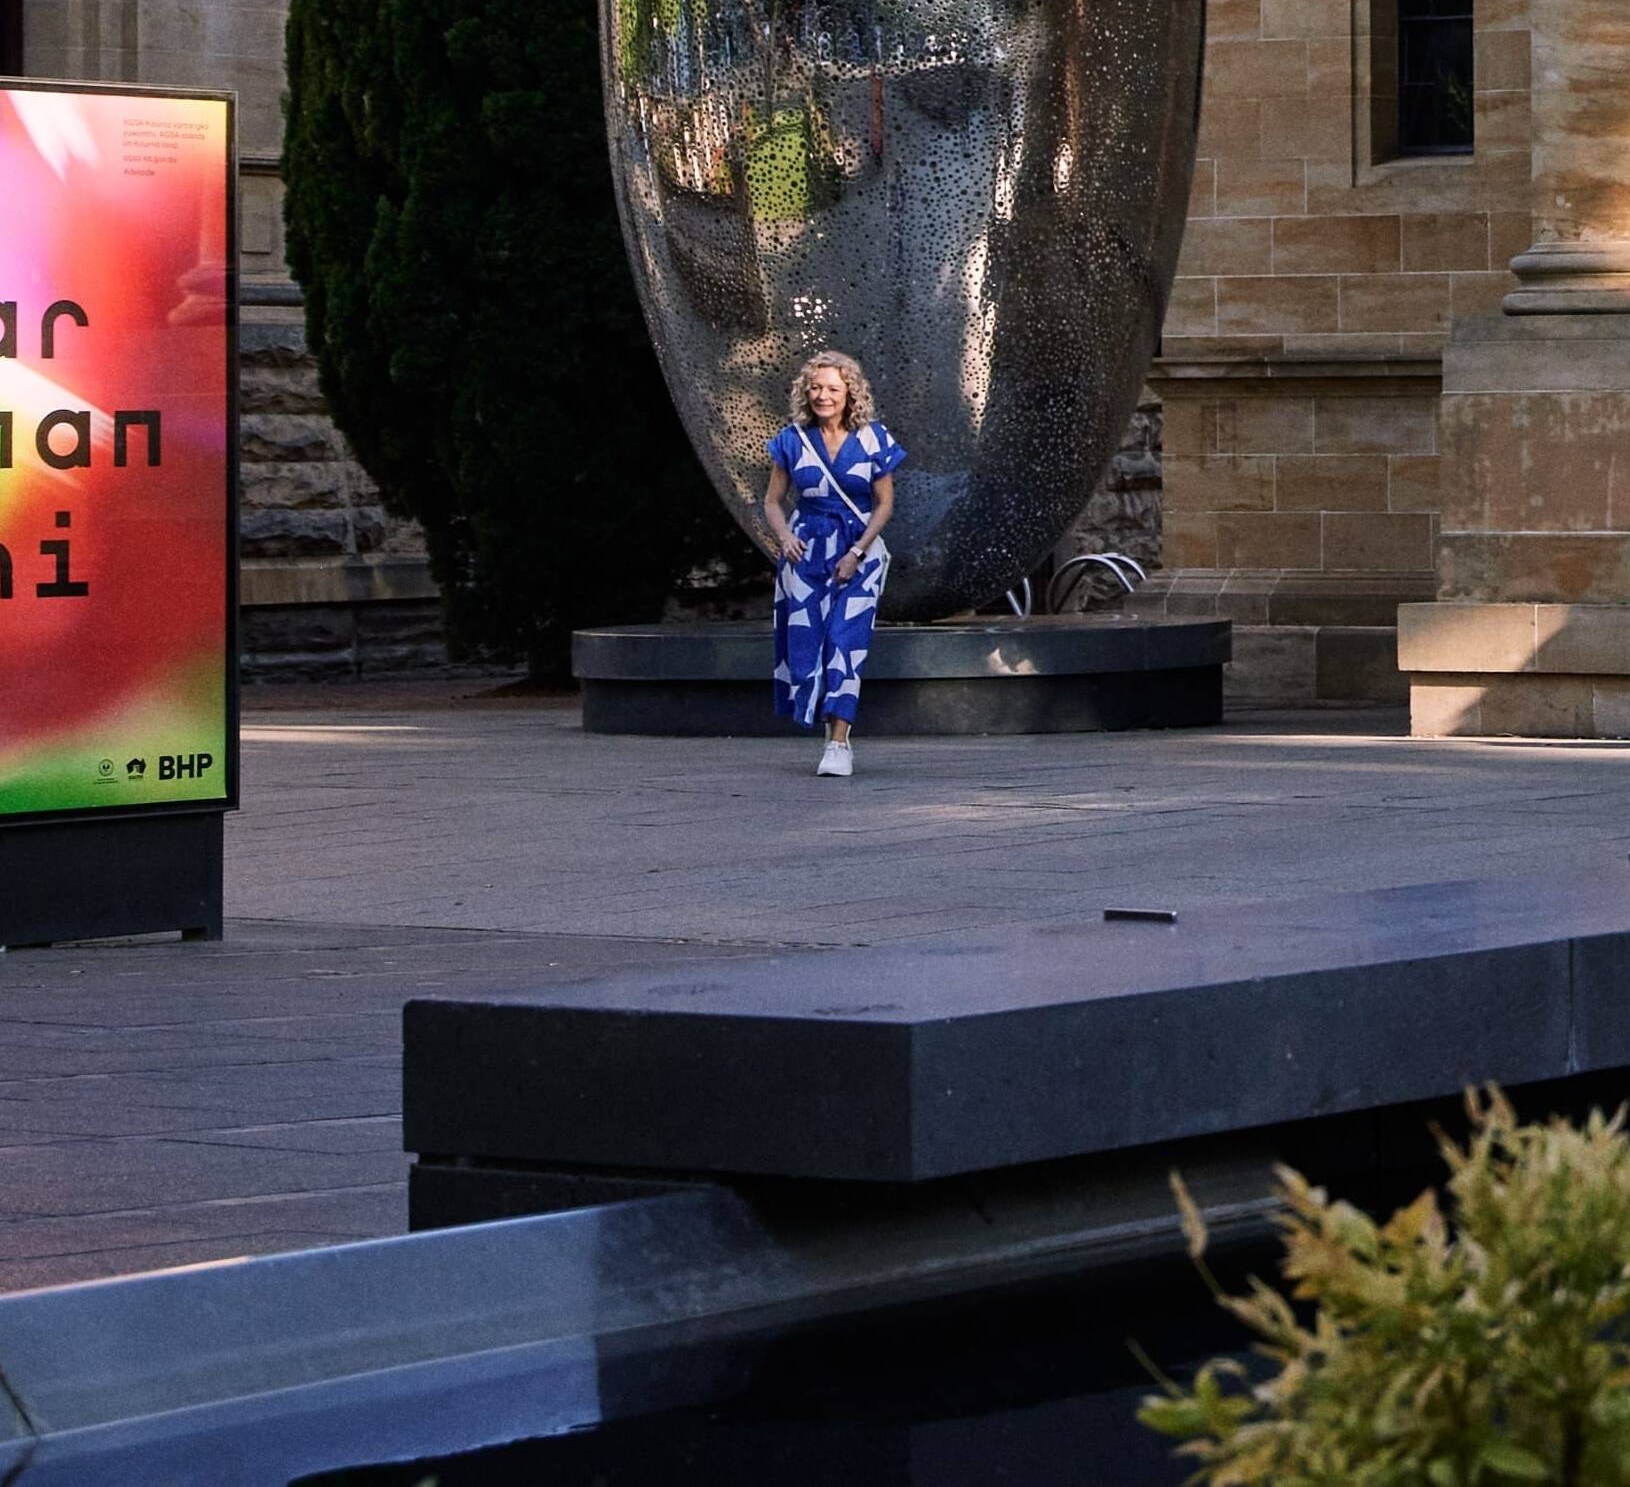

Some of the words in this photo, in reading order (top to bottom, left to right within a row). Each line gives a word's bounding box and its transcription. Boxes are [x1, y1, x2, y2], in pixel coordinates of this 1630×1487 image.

[0, 409, 161, 469] an
[0, 511, 88, 598] i
[158, 753, 213, 780] BHP
